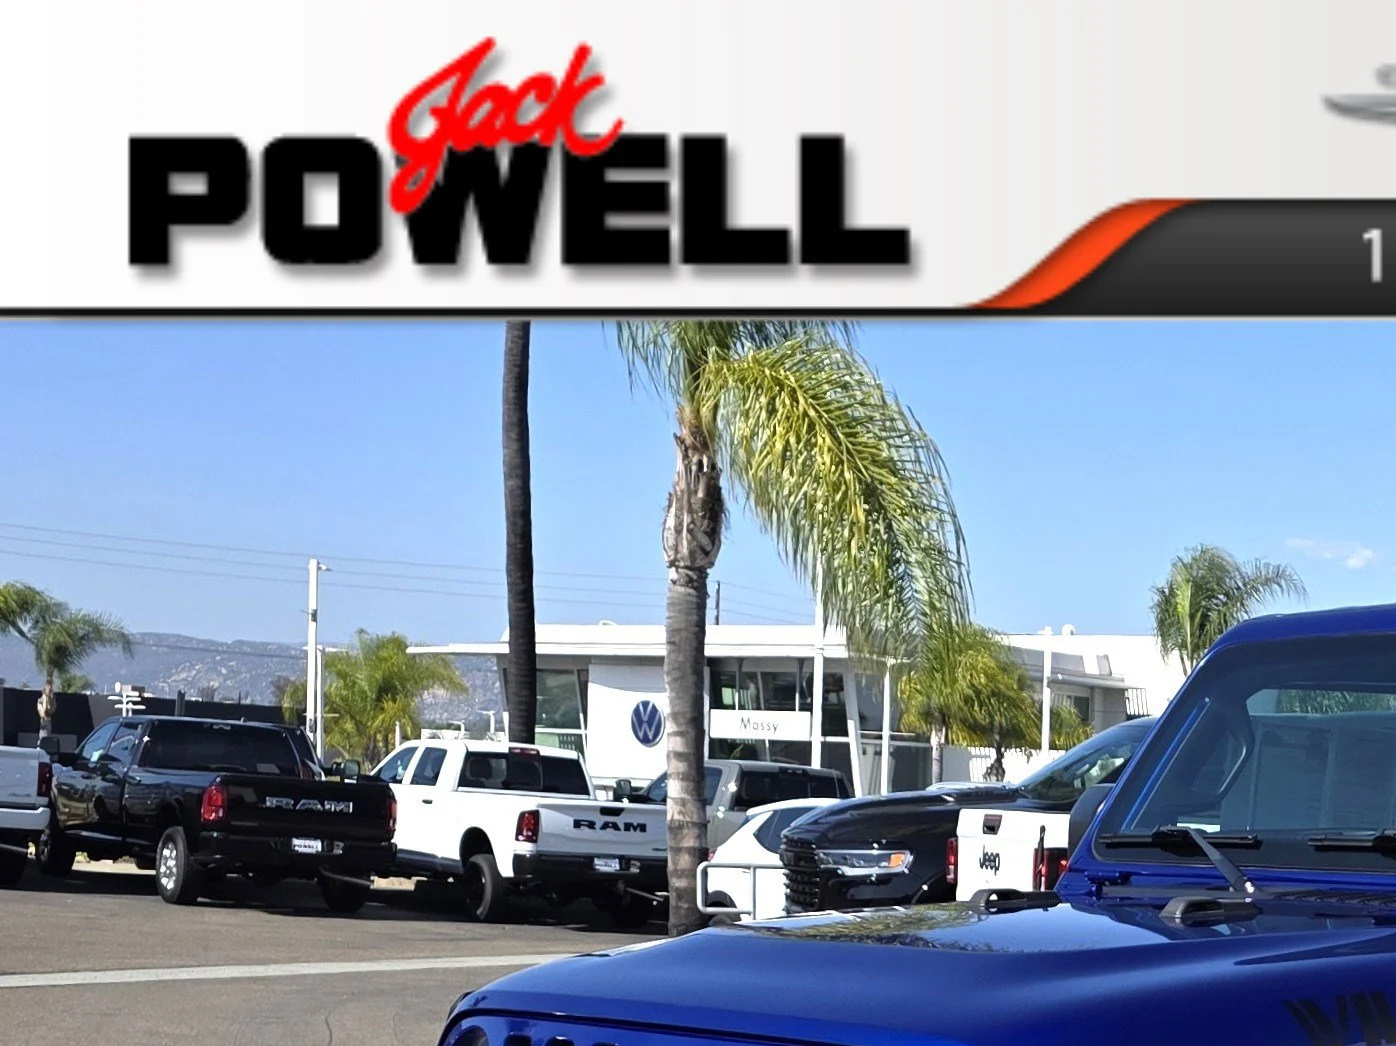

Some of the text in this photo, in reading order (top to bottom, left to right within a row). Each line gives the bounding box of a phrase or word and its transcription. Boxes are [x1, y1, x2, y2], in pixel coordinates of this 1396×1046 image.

[740, 717, 779, 733] Mossy
[265, 796, 354, 814] RAM
[572, 818, 647, 833] RAM
[979, 844, 1001, 876] Jeep
